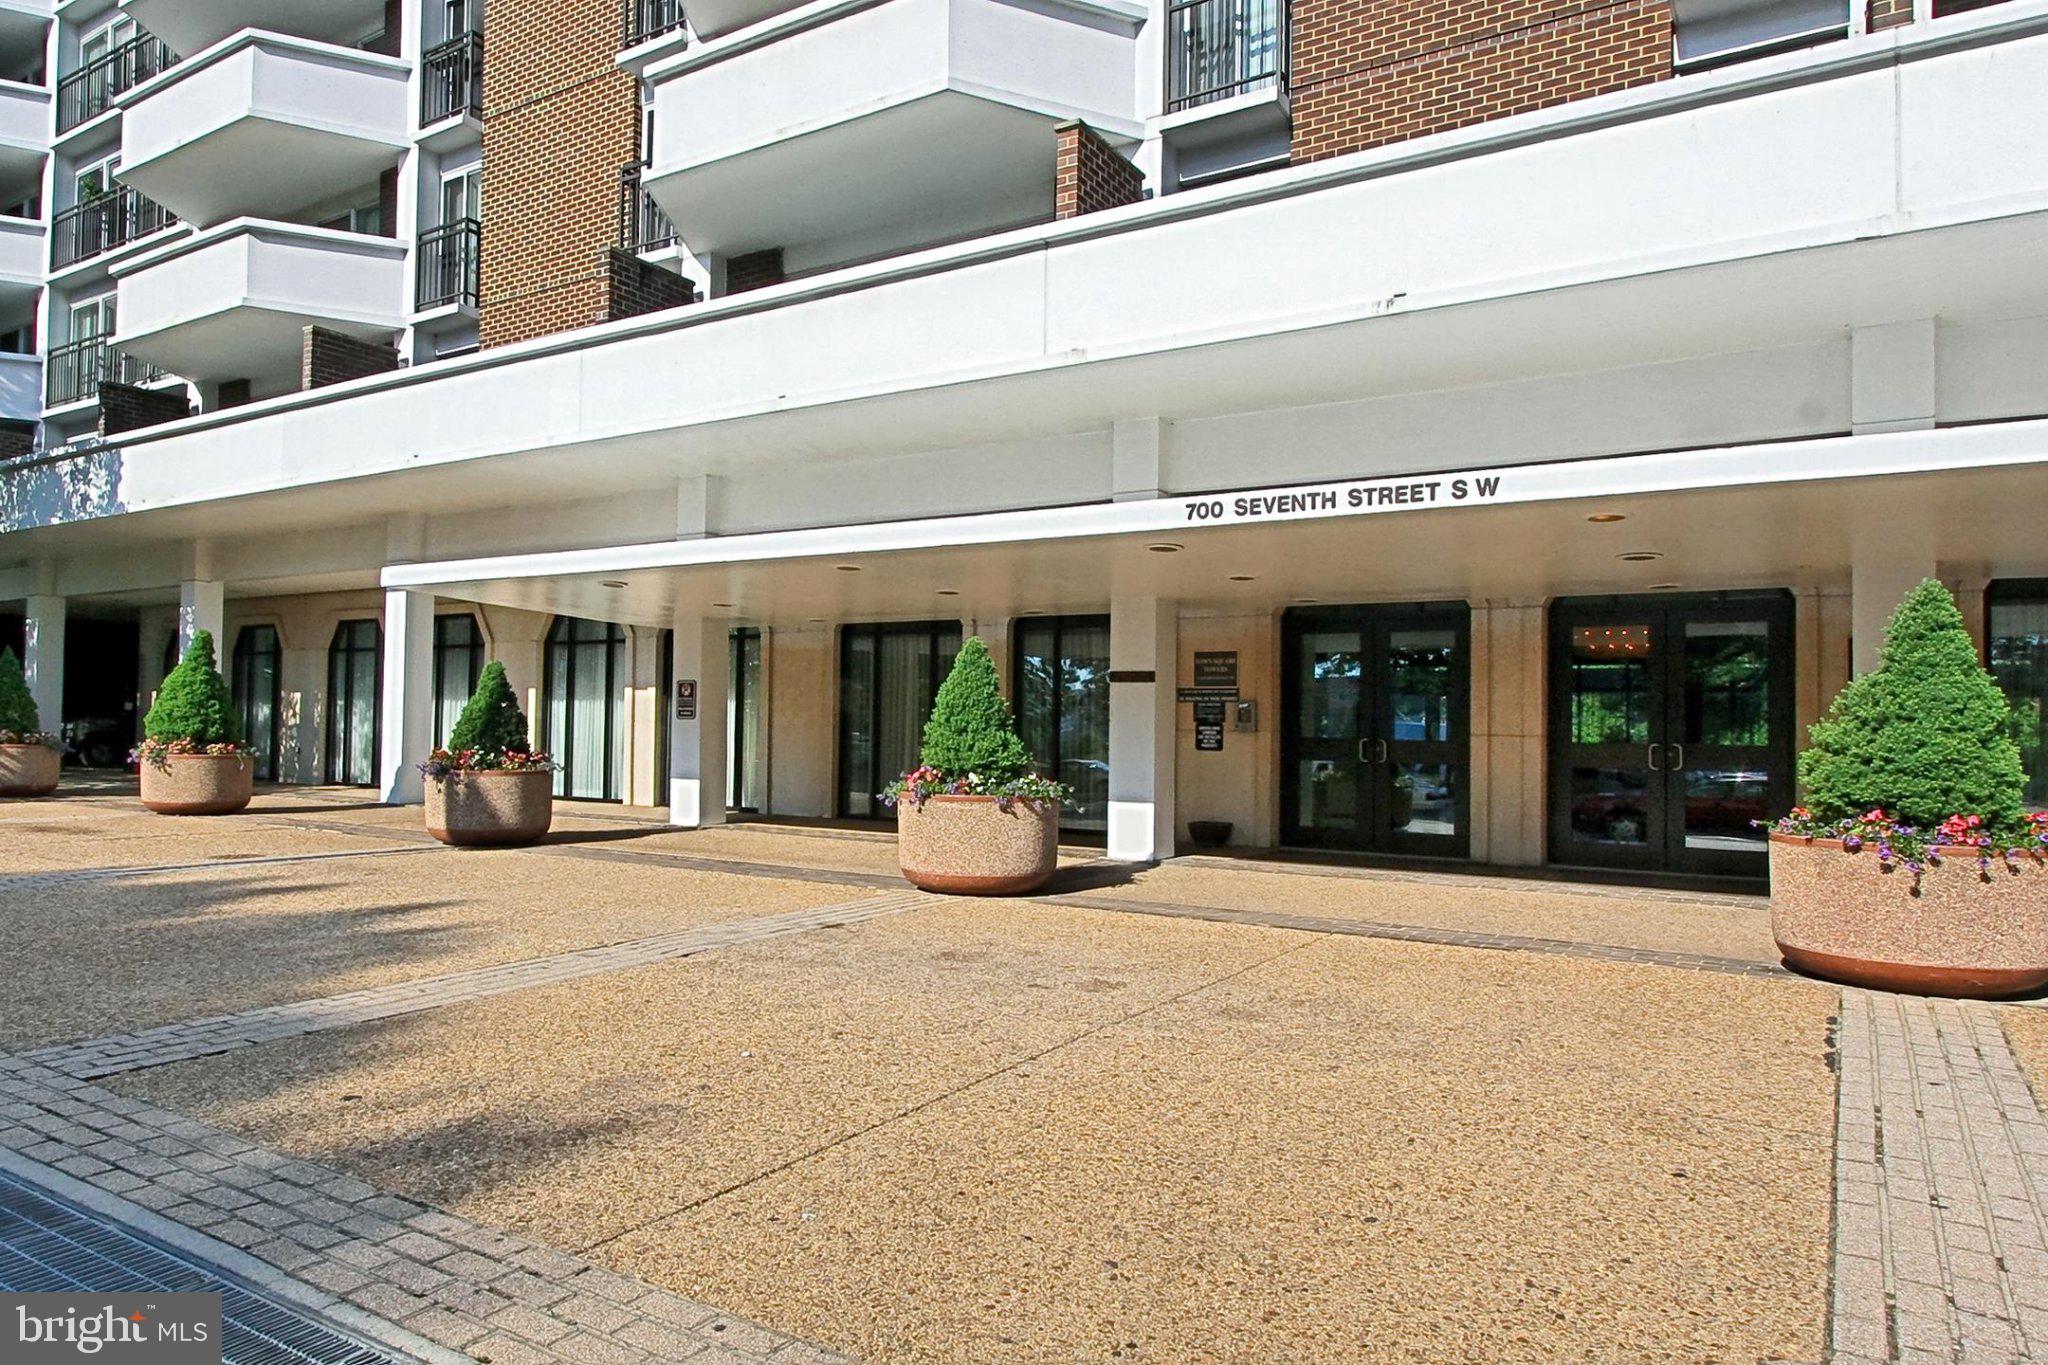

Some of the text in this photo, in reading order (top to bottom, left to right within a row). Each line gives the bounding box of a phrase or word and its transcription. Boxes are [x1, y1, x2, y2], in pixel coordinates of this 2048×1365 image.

[1185, 477, 1501, 521] 700 SEVENTH STREET S W
